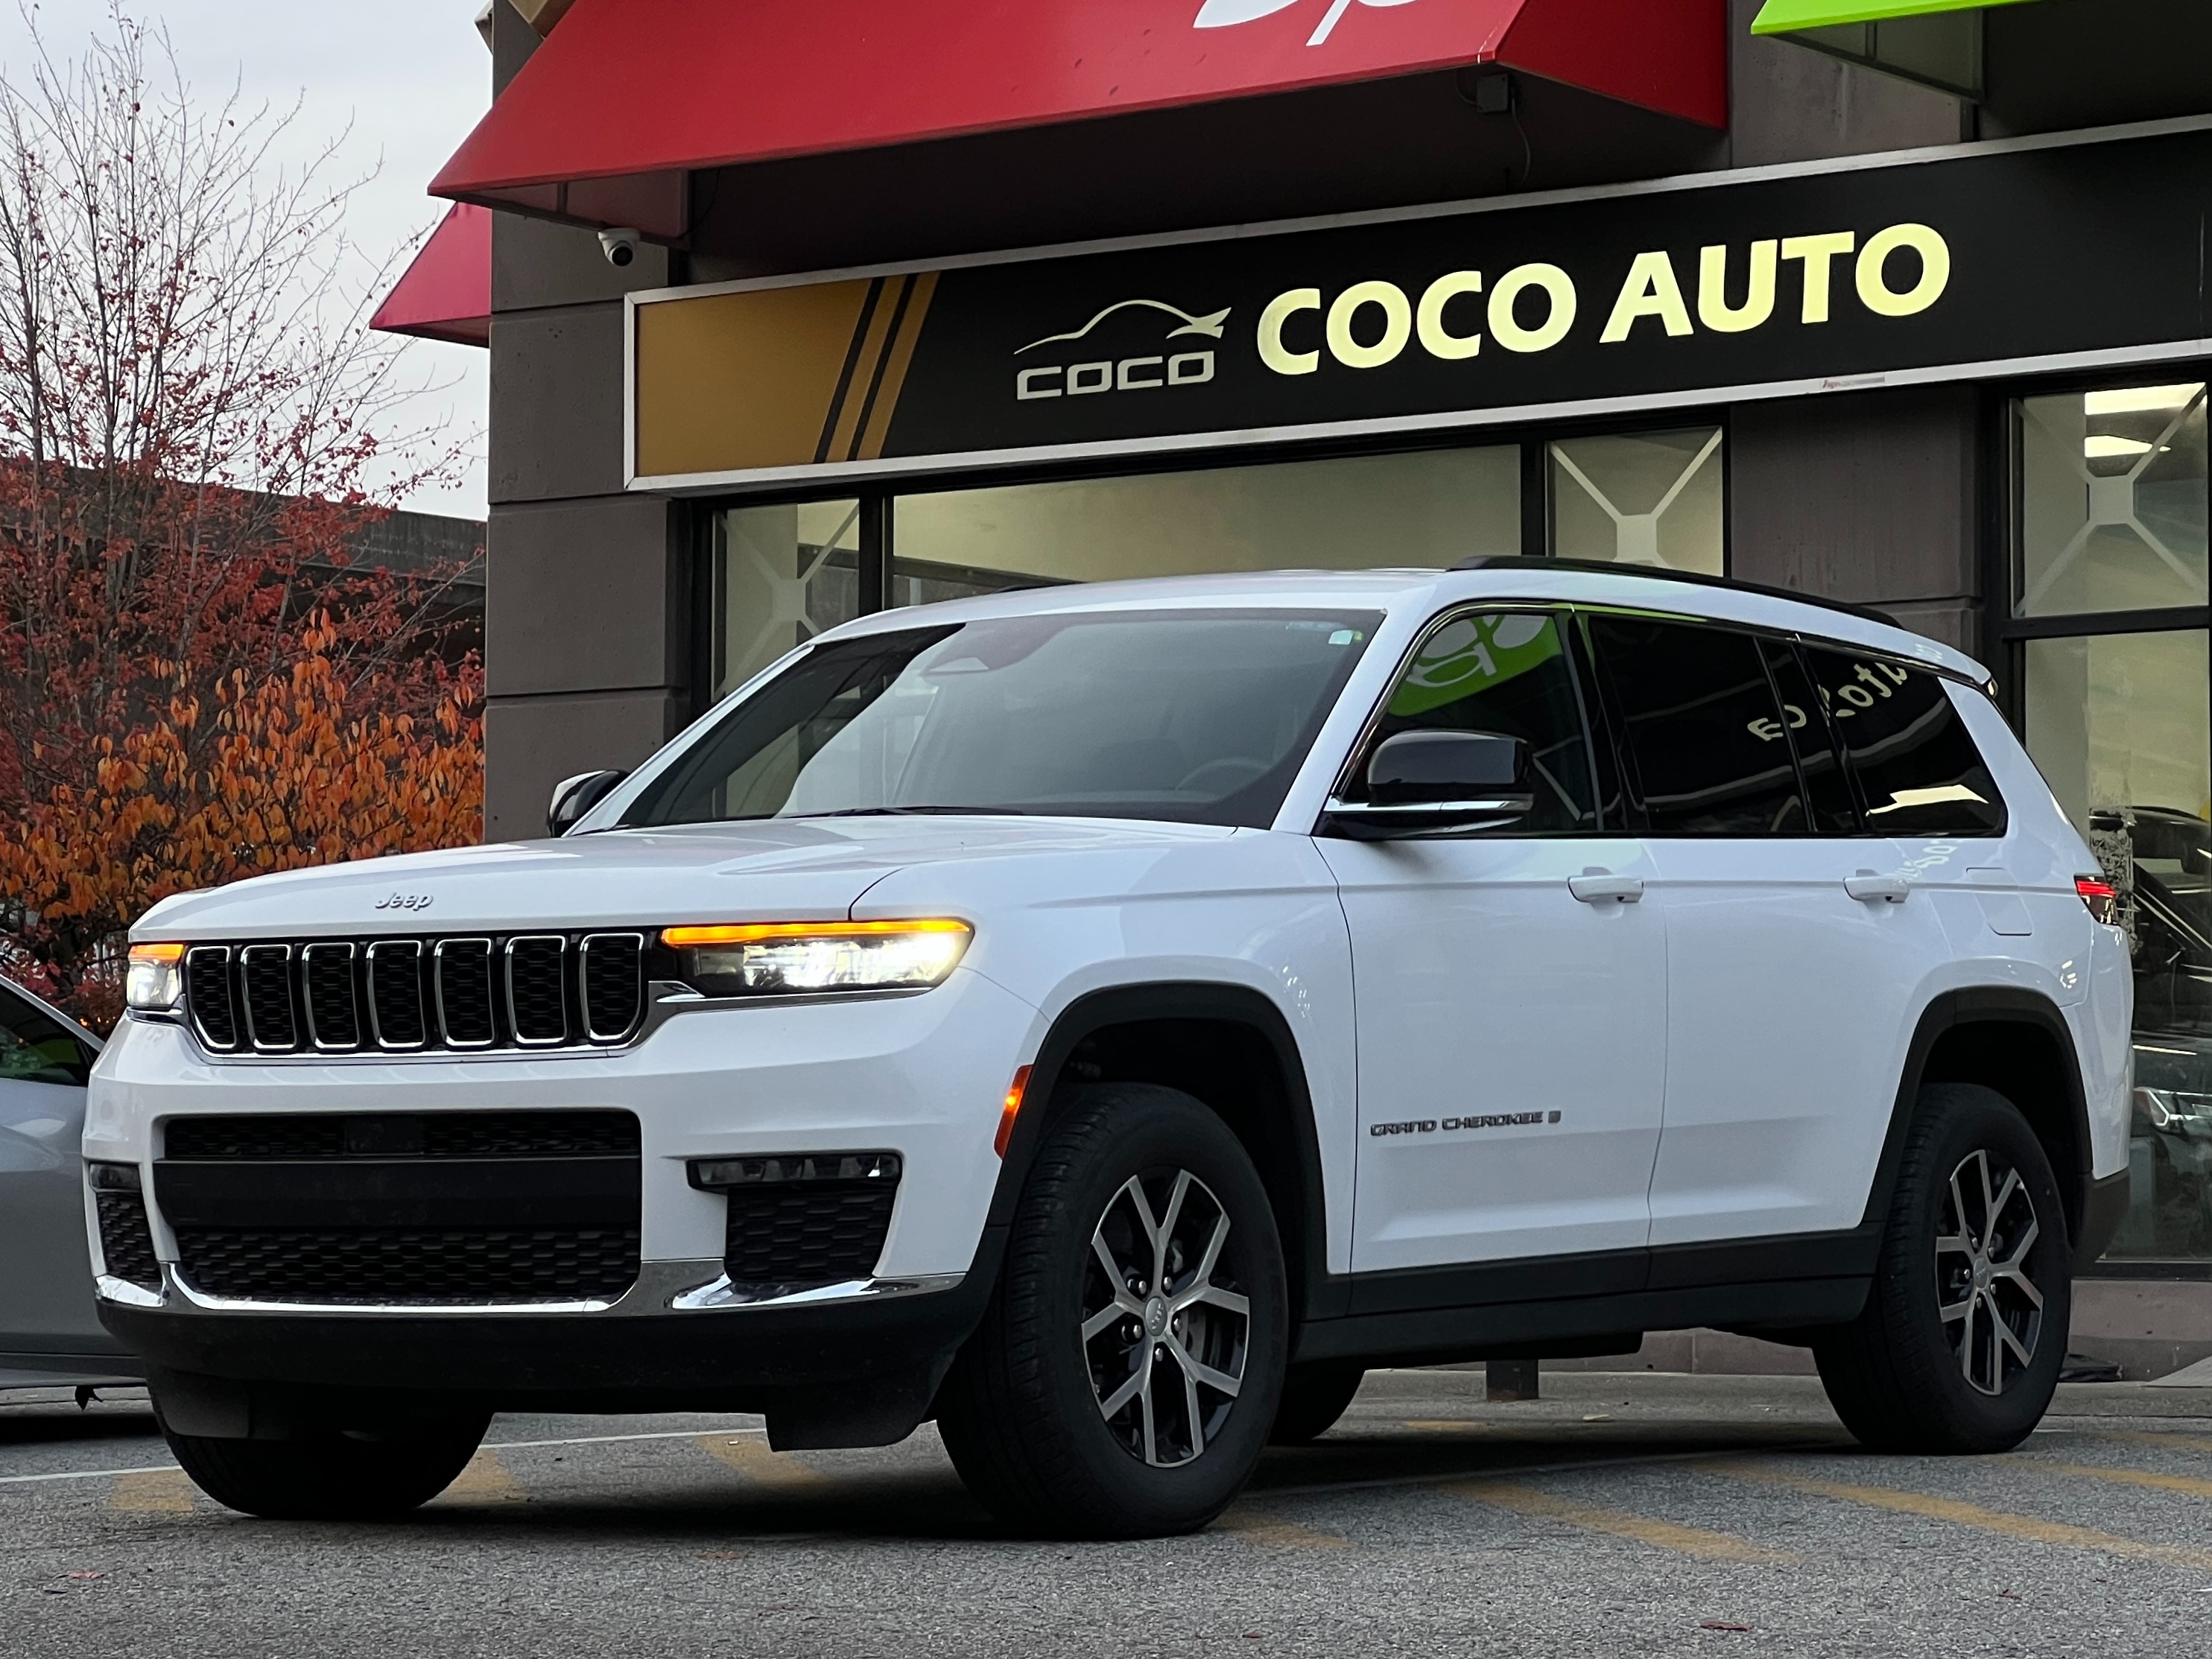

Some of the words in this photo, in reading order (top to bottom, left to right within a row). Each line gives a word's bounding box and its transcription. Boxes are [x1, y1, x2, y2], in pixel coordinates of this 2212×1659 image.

[1257, 263, 1577, 375] COCO
[1600, 223, 1950, 343] AUTO
[1017, 350, 1214, 400] COCO
[375, 892, 434, 912] Jeep
[1370, 1120, 1437, 1137] GRAND
[1442, 1111, 1544, 1131] CHEROKEE
